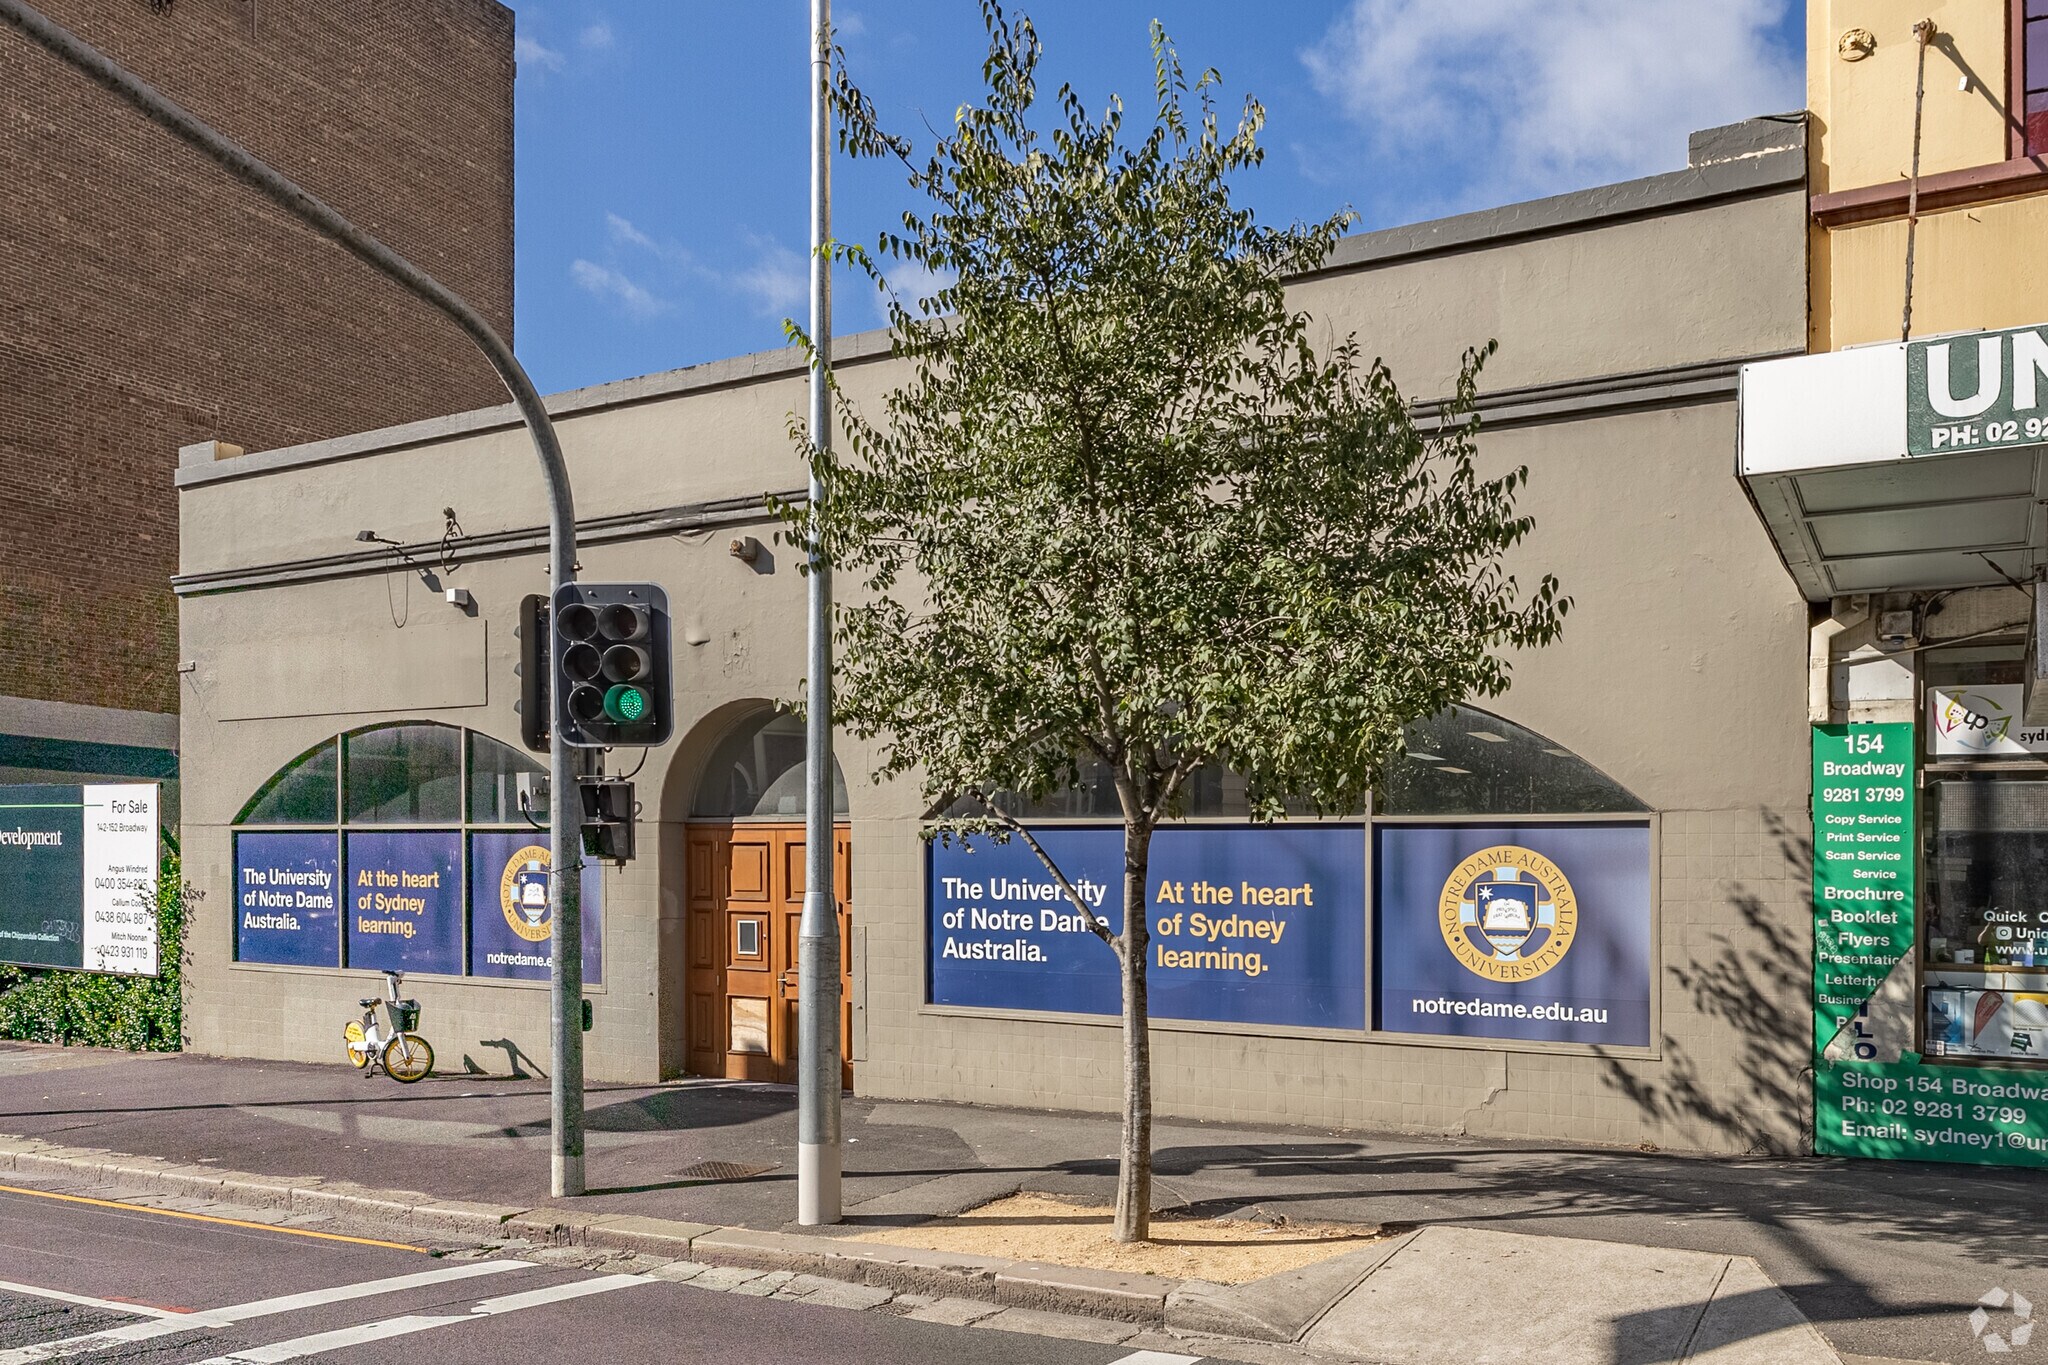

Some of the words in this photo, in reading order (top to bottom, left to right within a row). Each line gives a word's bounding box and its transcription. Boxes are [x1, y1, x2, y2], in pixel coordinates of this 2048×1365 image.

[1931, 425, 1979, 449] PH:
[1985, 420, 2019, 442] 02
[1844, 734, 1884, 754] 154
[1823, 761, 1905, 778] Broadway
[1823, 787, 1860, 803] 9281
[1865, 787, 1904, 803] 3799
[112, 800, 126, 813] For
[129, 800, 148, 813] Sale
[119, 823, 148, 833] Broadway
[1825, 814, 1855, 826] Copy
[1858, 814, 1902, 824] Service
[1826, 833, 1854, 842] Print
[1856, 833, 1900, 842] Service
[1825, 851, 1855, 861] Scan
[1857, 851, 1901, 861] Service
[108, 865, 125, 875] Angus
[126, 864, 148, 874] Windred
[243, 868, 266, 885] The
[269, 869, 332, 889] University
[503, 867, 514, 908] NOTRE
[512, 848, 538, 868] DAME
[1853, 869, 1897, 879] Service
[95, 877, 116, 889] 0400
[117, 878, 131, 890] 354
[357, 870, 372, 887] At
[376, 870, 399, 887] the
[402, 871, 439, 889] heart
[243, 891, 257, 907] of
[259, 891, 293, 908] Notre
[296, 892, 333, 909] Dame
[942, 877, 983, 901] The
[990, 878, 1107, 907] University
[1156, 880, 1184, 904] At
[1191, 881, 1233, 905] the
[1241, 881, 1313, 907] heart
[1444, 875, 1467, 934] NOTRE
[1463, 850, 1513, 878] DAME
[1516, 853, 1572, 937] AUSTRALIA
[1824, 886, 1904, 901] Brochure
[358, 893, 372, 910] of
[375, 893, 425, 915] Sydney
[95, 910, 115, 923] 0438
[116, 911, 132, 924] 604
[134, 912, 148, 924] 887
[243, 912, 301, 930] Australia.
[508, 912, 551, 939] UNIVERSI
[942, 908, 963, 929] of
[971, 908, 1034, 931] Notre
[1040, 909, 1109, 933] Dame
[1830, 909, 1898, 924] Booklet
[1983, 910, 2028, 923] Quick
[358, 916, 417, 939] learning.
[1157, 912, 1182, 936] of
[1189, 912, 1286, 944] Sydney
[111, 932, 126, 940] Mitch
[127, 933, 148, 942] Noonan
[1838, 932, 1890, 948] Flyers
[100, 945, 119, 958] 0423
[121, 946, 134, 958] 931
[136, 947, 148, 959] 119
[942, 937, 1047, 962] Australia.
[1995, 945, 2048, 956] www.u
[1157, 945, 1268, 977] learning.
[1456, 942, 1560, 979] UNIVERSITY
[1412, 997, 1608, 1024] notredame.edu.au
[1842, 1071, 1898, 1093] Shop
[1906, 1077, 1943, 1094] 154
[1952, 1079, 2048, 1101] Broadwa
[1842, 1095, 1876, 1113] Ph:
[1882, 1099, 1908, 1116] 02
[1914, 1102, 1964, 1120] 9281
[1972, 1105, 2027, 1124] 3799
[1841, 1120, 1907, 1140] Email:
